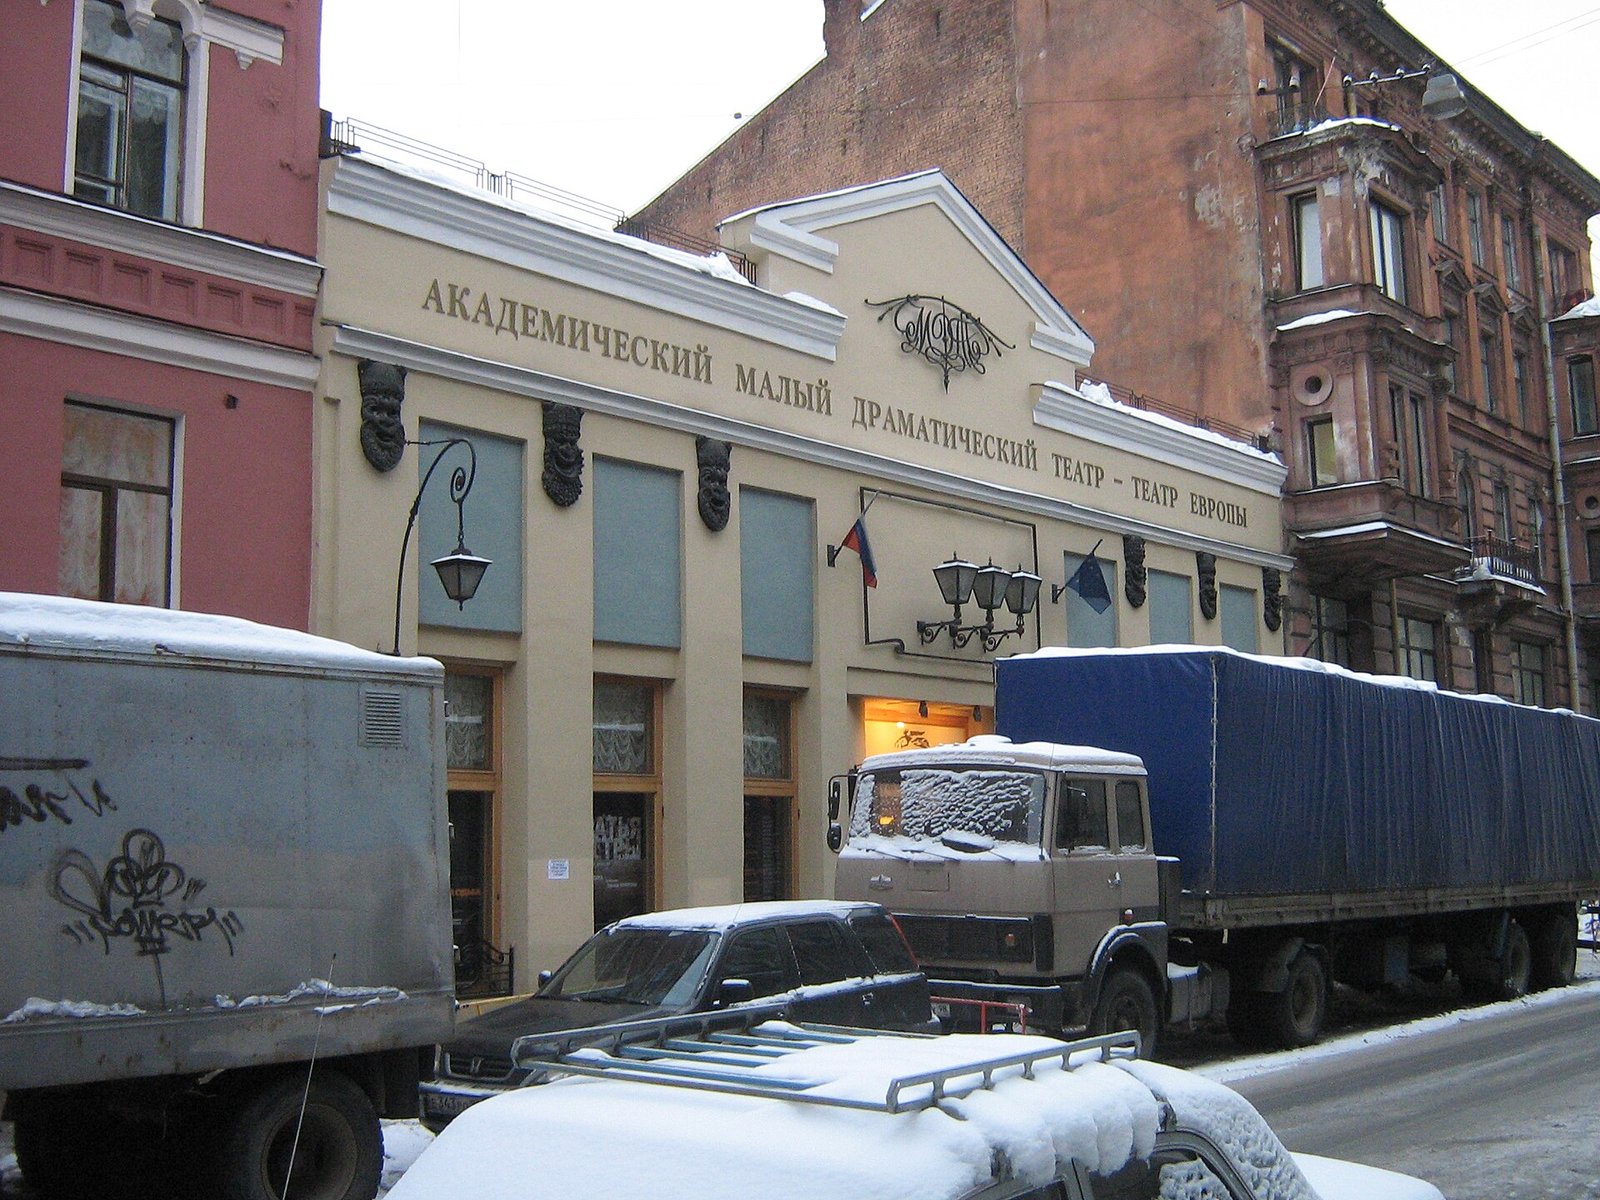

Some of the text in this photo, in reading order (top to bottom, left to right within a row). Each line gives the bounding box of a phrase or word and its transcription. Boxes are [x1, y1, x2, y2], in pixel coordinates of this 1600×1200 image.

[422, 278, 713, 384] АКАДЕМИЧЕСКИЙ
[735, 363, 832, 416] МАЛЫЙ
[852, 396, 1039, 472] ДРАМАТИЧЕСКИЙ
[1051, 453, 1105, 489] ТЕАТР
[1131, 476, 1178, 509] ТЕАТР
[1190, 491, 1248, 528] ЕВРОПЫ
